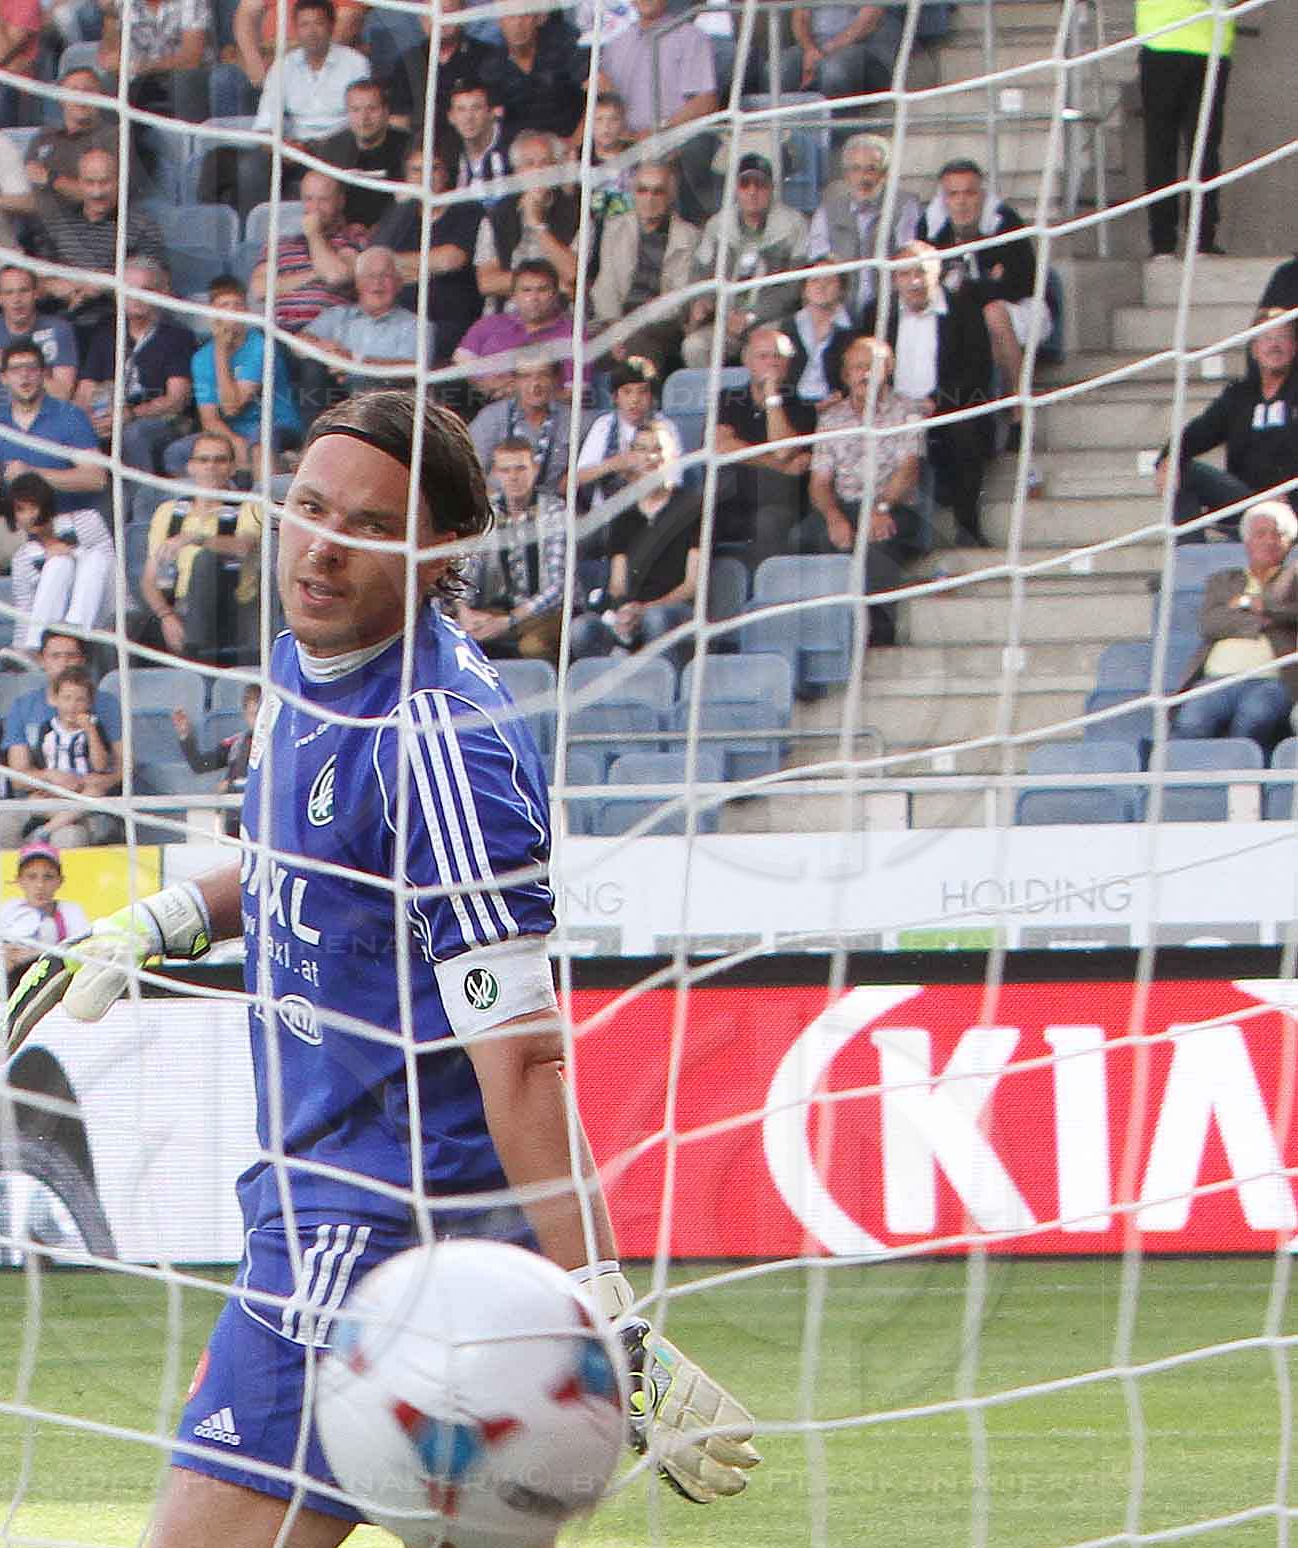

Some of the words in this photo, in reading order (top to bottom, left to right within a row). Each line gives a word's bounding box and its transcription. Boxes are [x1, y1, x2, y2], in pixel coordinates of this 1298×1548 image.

[940, 876, 1132, 914] HOLDING
[870, 1023, 1296, 1232] KIA
[193, 1423, 241, 1446] adidas
